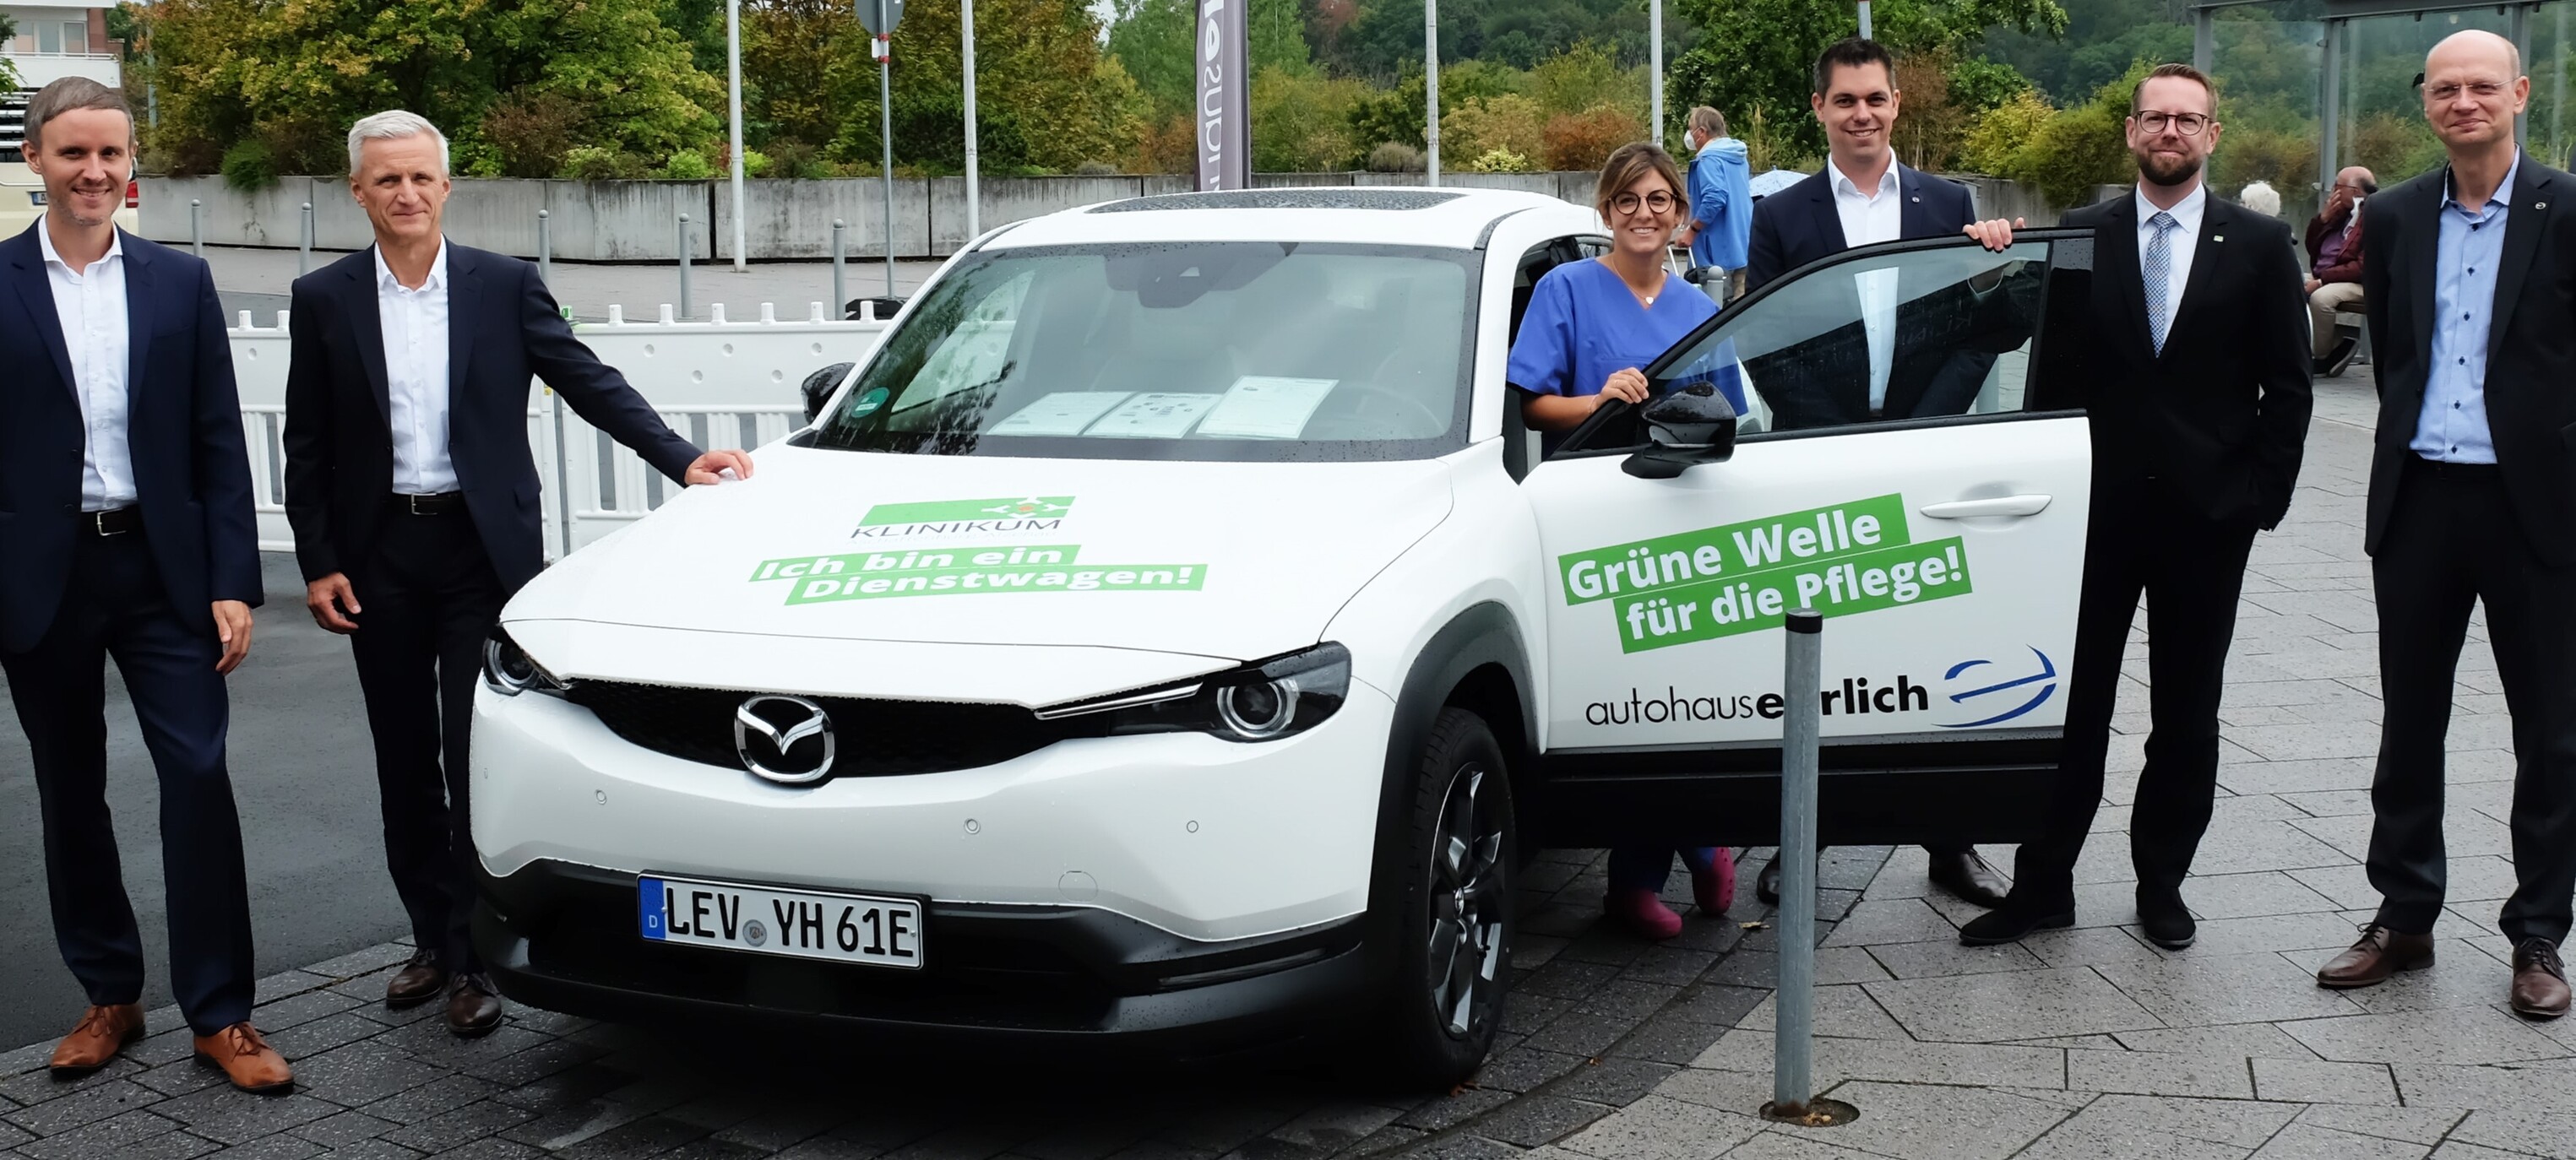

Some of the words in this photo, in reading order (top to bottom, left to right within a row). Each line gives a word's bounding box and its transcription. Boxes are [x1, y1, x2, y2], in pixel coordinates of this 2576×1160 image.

[850, 519, 1062, 539] KLINIKUM
[758, 556, 846, 579] Ich
[862, 545, 965, 572] bin
[971, 545, 1063, 565] ein
[1568, 545, 1722, 599] Grüne
[1731, 509, 1882, 567] Welle
[800, 566, 1194, 599] Dienstwagen!
[1626, 598, 1698, 640] für
[1710, 582, 1785, 625] die
[1796, 545, 1963, 609] Pflege!
[648, 914, 658, 929] D
[666, 886, 740, 940] LEV
[772, 898, 824, 950] YH
[836, 905, 914, 957] 61E
